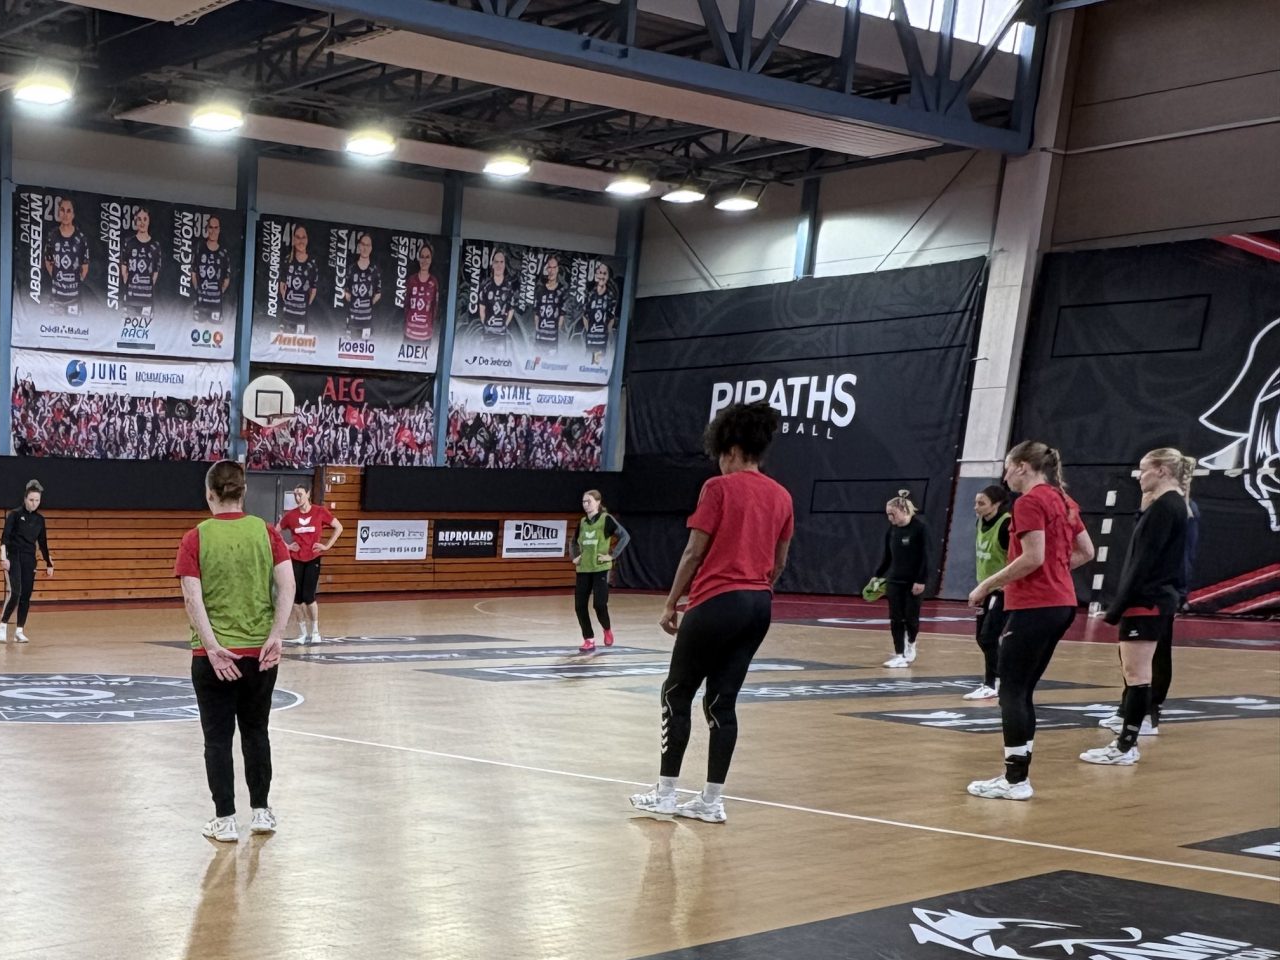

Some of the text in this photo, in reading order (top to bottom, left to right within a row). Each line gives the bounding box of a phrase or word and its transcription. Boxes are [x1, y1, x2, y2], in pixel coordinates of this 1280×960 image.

[29, 193, 43, 304] ABDESSELAM
[179, 211, 194, 298] FRACHON
[334, 229, 349, 308] TUCCELLA
[90, 362, 127, 381] JUNG
[398, 343, 430, 360] ADEX
[322, 376, 366, 403] AEG
[708, 373, 858, 428] PIRATHS
[781, 421, 834, 440] BALL
